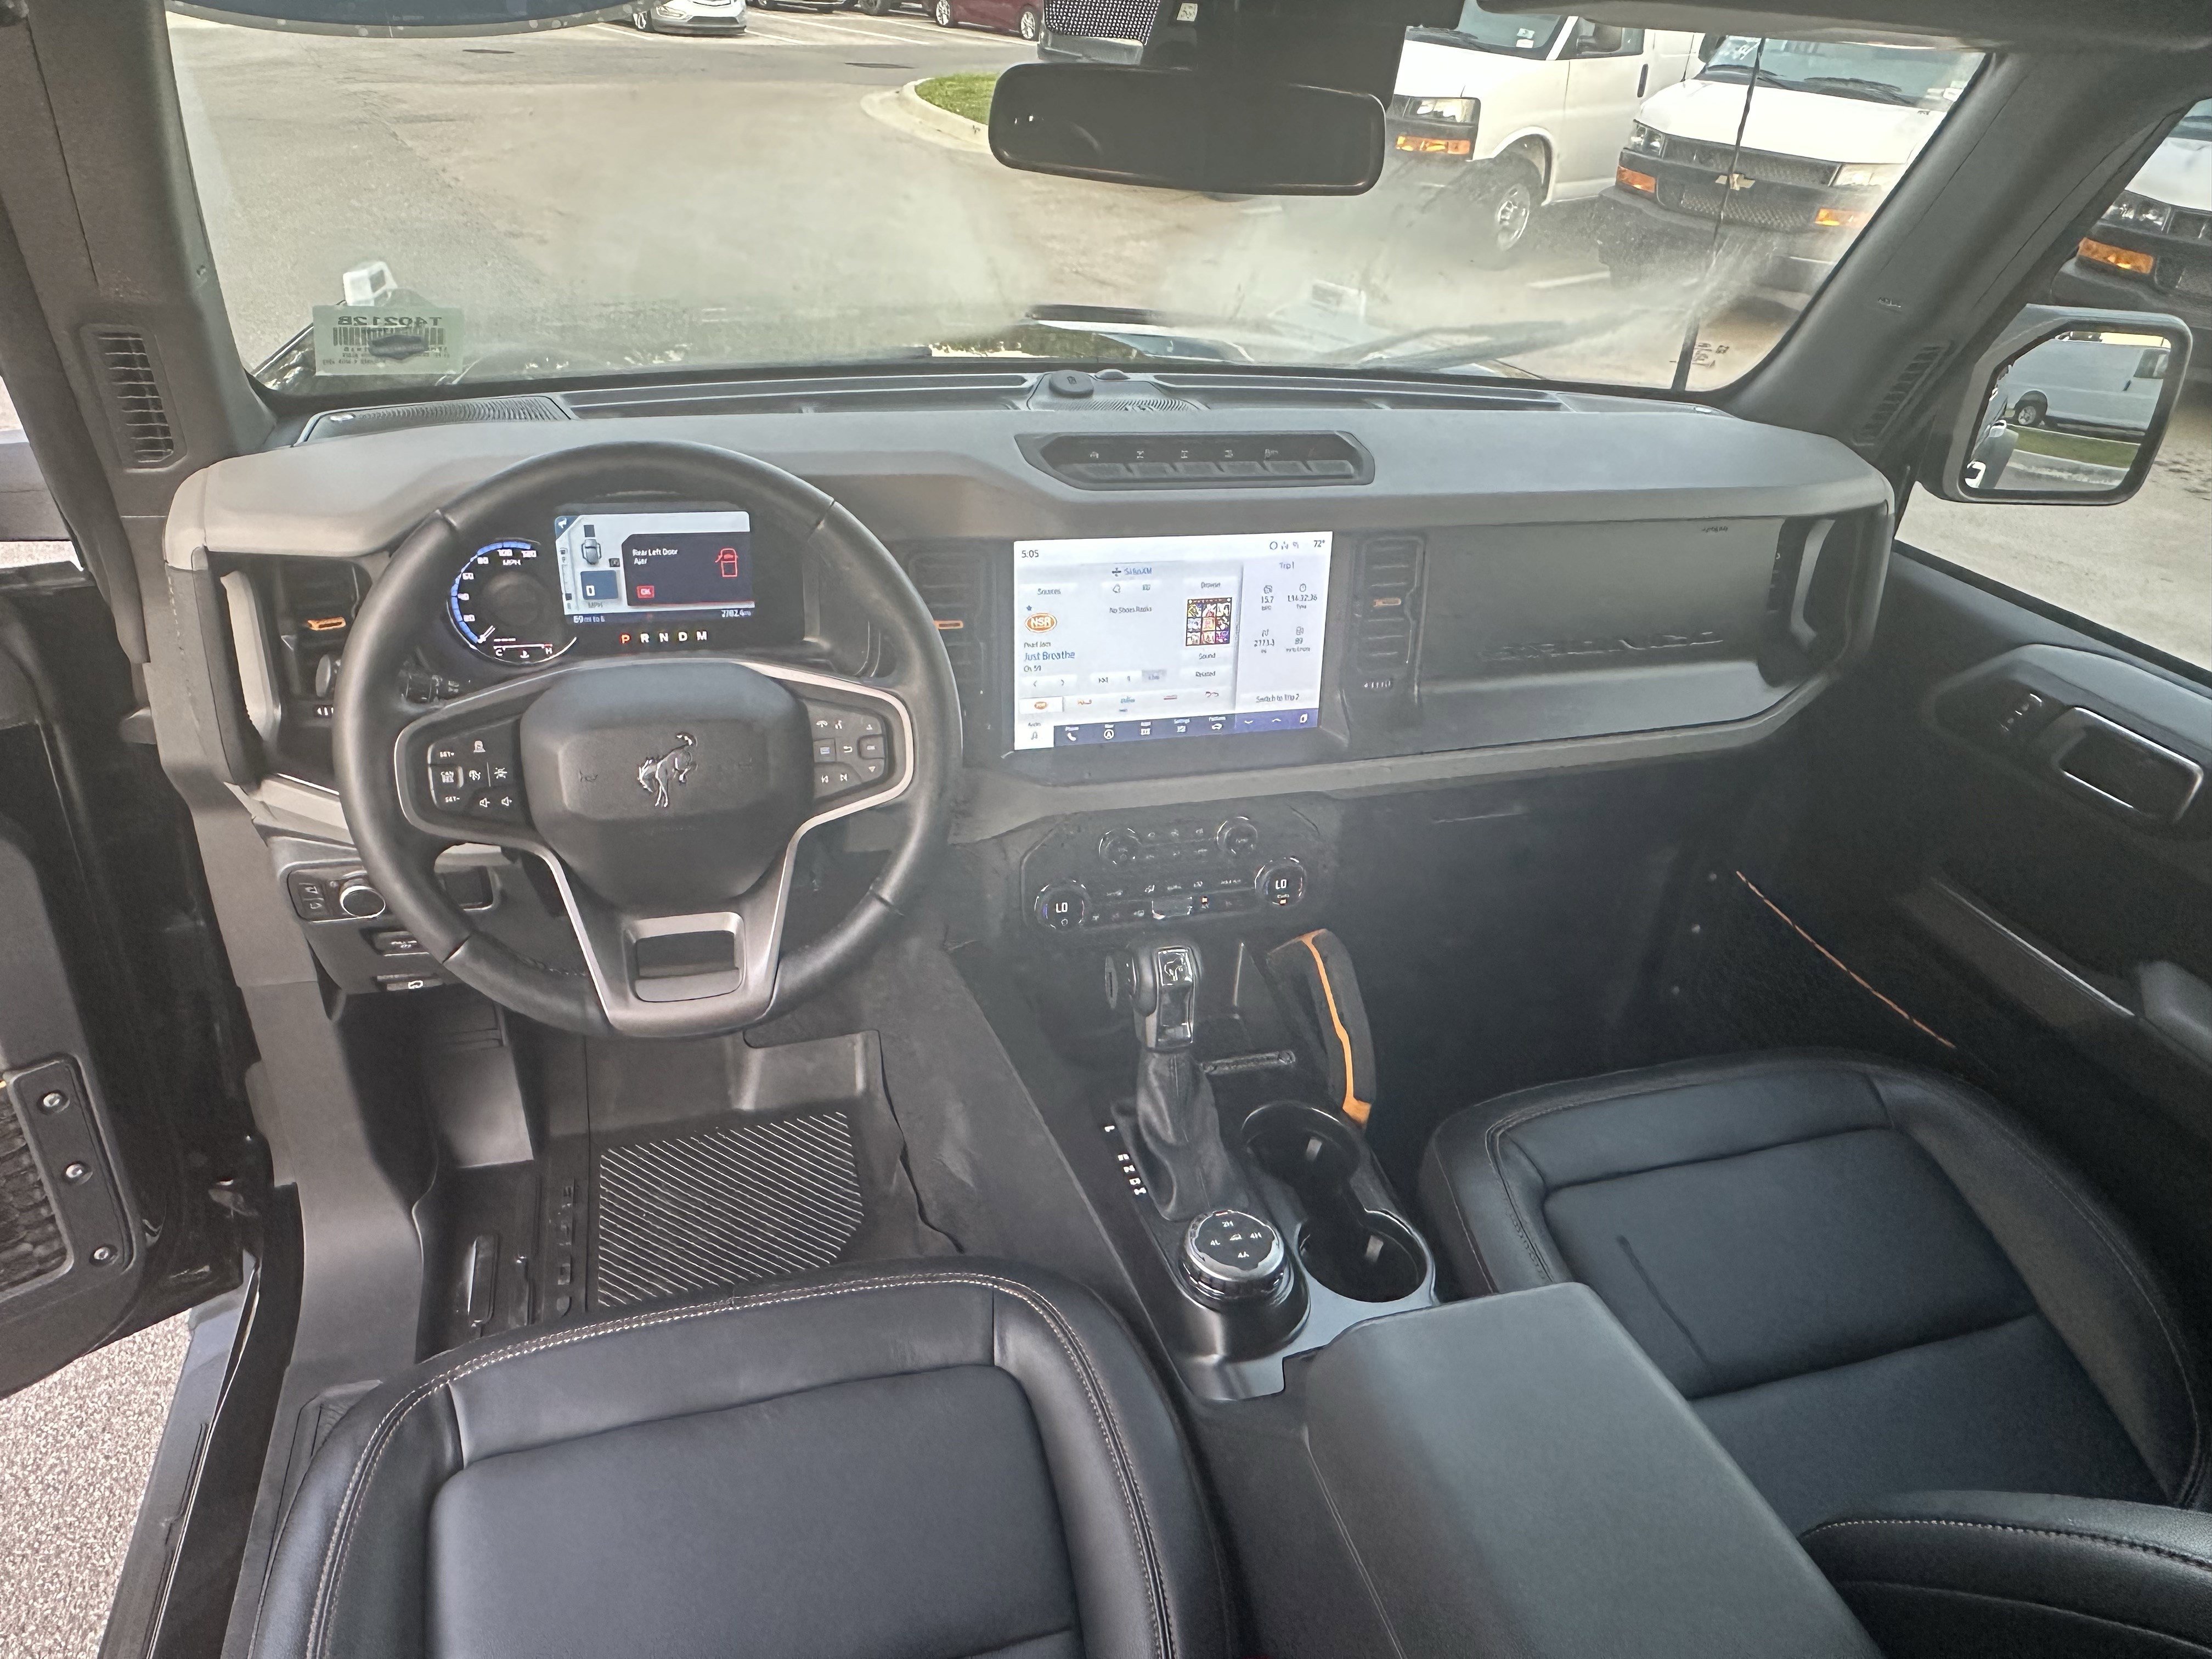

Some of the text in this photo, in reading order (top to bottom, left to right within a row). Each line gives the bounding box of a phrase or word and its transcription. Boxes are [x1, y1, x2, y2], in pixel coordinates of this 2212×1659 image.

[1021, 550, 1039, 558] 5:05
[622, 631, 708, 644] P R N D M
[1024, 652, 1041, 662] Just
